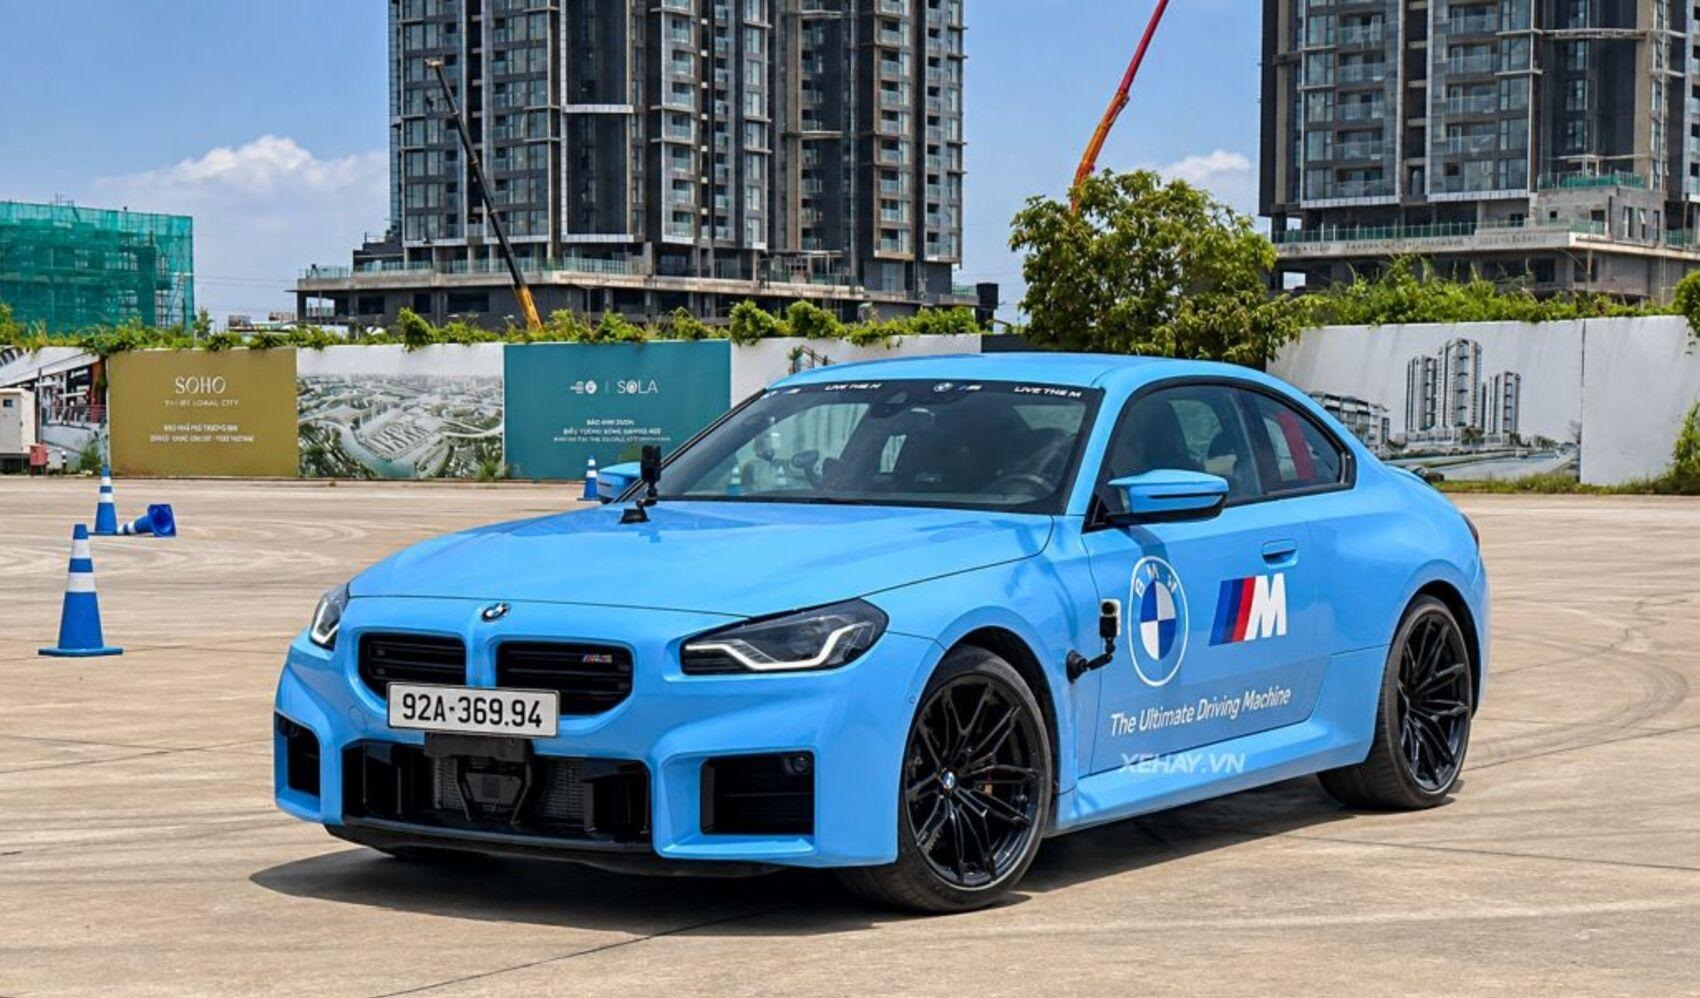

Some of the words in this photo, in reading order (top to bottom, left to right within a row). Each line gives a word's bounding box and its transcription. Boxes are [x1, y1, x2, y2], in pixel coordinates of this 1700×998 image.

[175, 376, 226, 394] SOHO
[617, 380, 659, 394] SOLA
[1014, 386, 1041, 394] LIVE
[1043, 387, 1067, 396] THE
[1240, 572, 1287, 643] M
[402, 693, 543, 728] 92A-369.94
[1110, 712, 1137, 736] The
[1139, 704, 1194, 731] Ultimate
[1197, 696, 1240, 719] Driving
[1242, 685, 1292, 709] Machine
